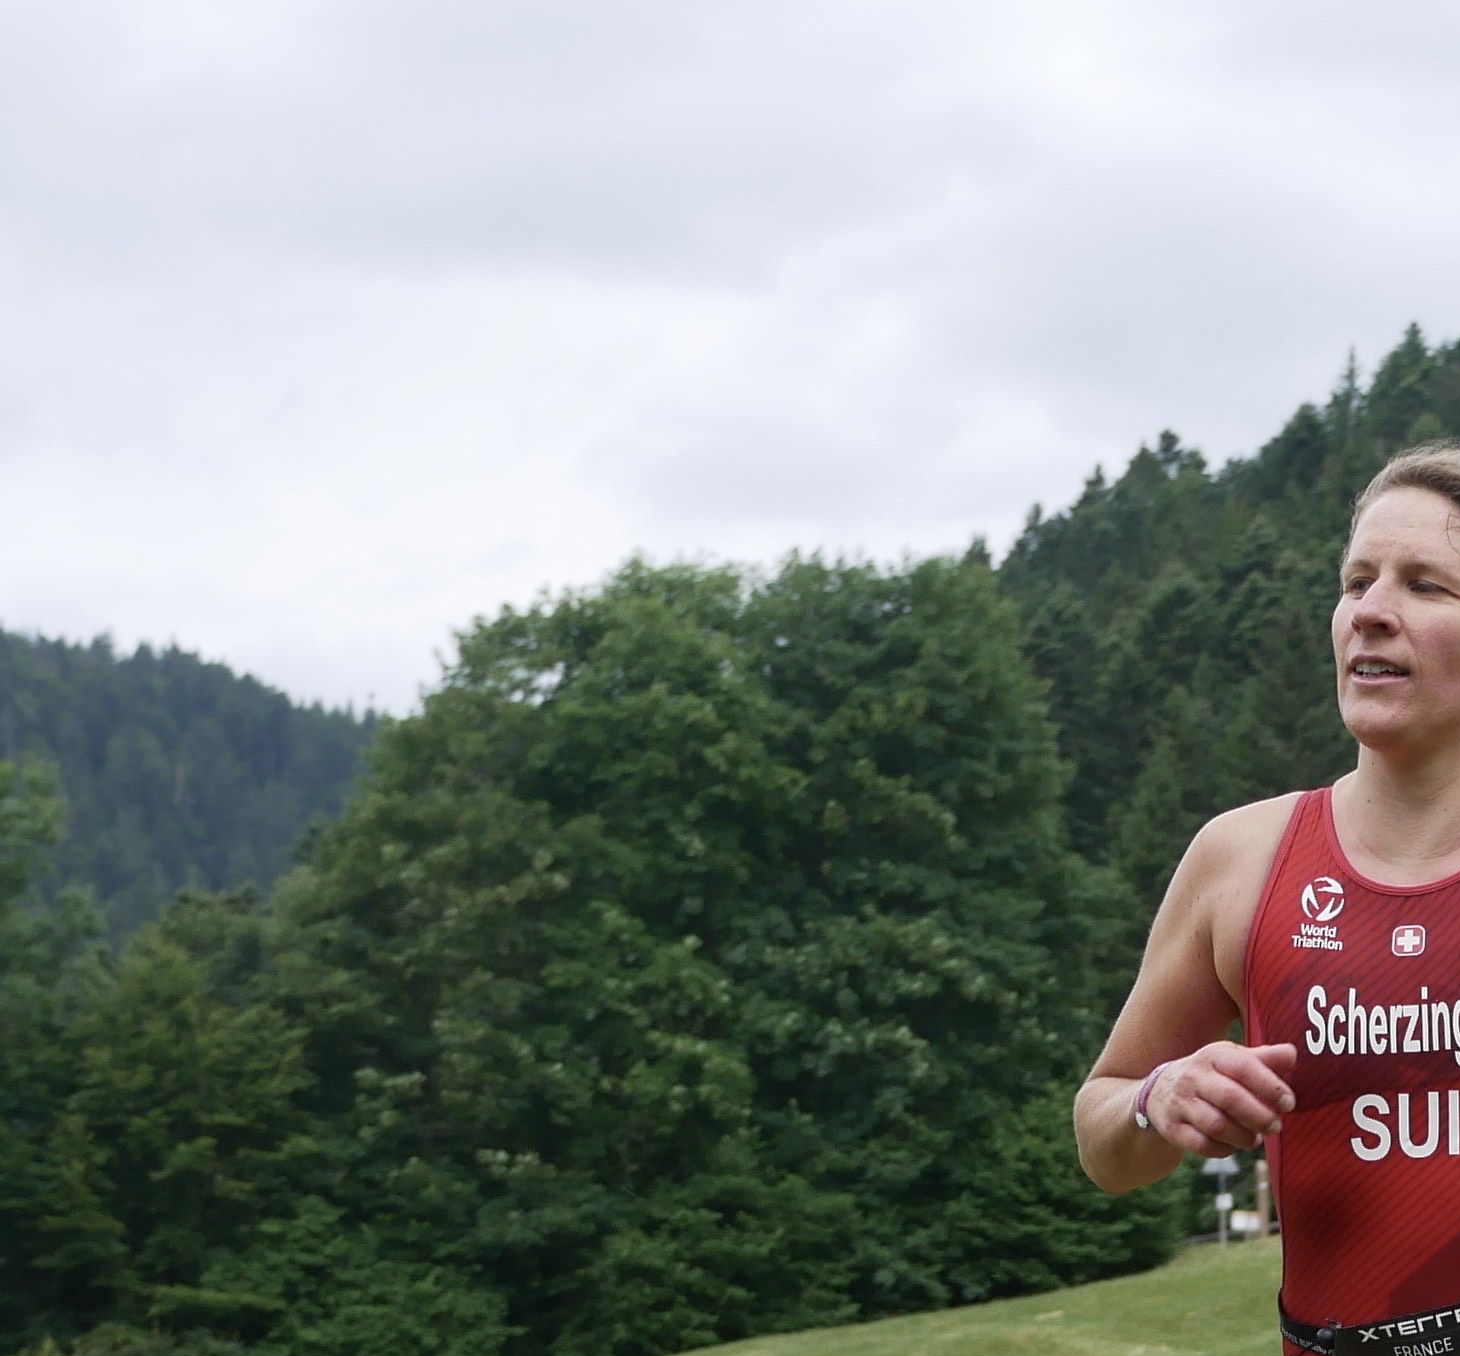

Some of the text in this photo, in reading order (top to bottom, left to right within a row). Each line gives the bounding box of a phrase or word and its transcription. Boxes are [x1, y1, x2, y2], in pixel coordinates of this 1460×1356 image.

[1300, 922, 1337, 938] World
[1291, 934, 1343, 951] Triathlon
[1350, 1090, 1460, 1161] SUI
